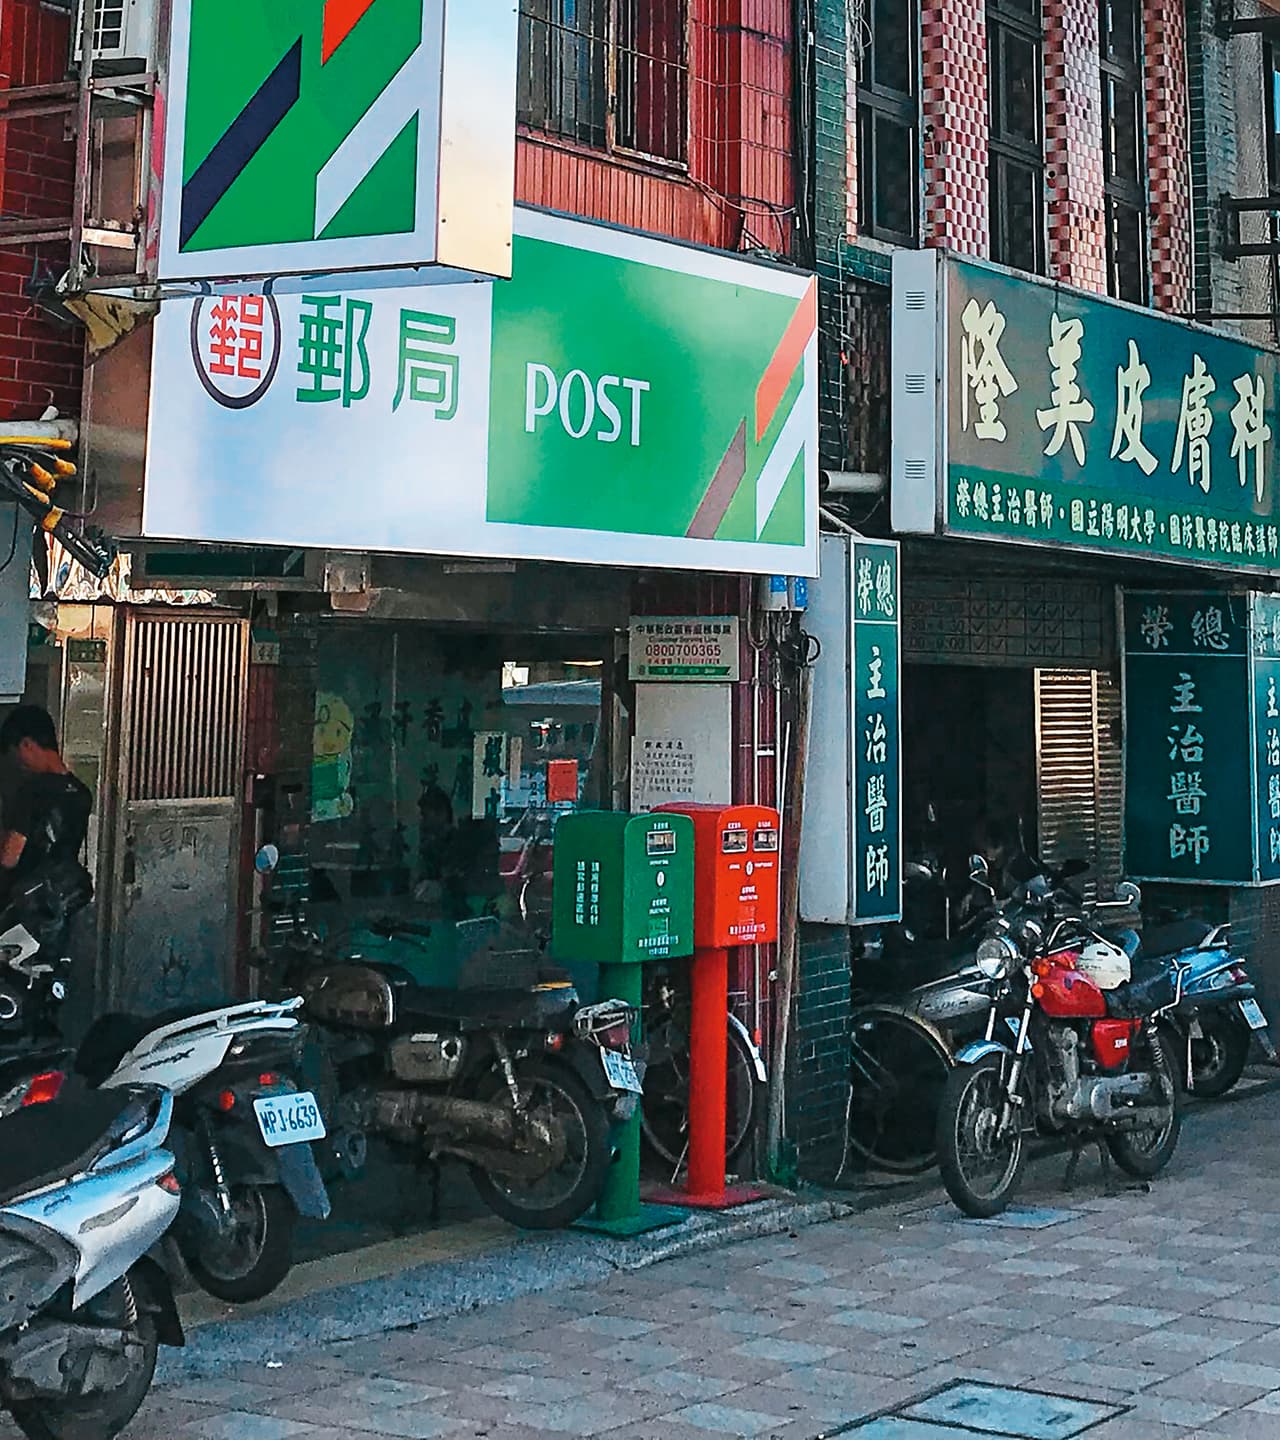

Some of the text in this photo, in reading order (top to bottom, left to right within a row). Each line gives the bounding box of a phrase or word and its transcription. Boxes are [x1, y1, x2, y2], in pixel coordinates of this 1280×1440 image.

[296, 294, 462, 422] 郵局
[525, 362, 651, 447] POST
[960, 297, 1272, 504] 隆美皮膚科
[857, 557, 895, 617] 榮總
[1139, 605, 1230, 652] 榮總
[645, 644, 721, 657] 0800700365
[865, 646, 889, 898] 主治醫師
[1166, 672, 1210, 865] 主治醫師
